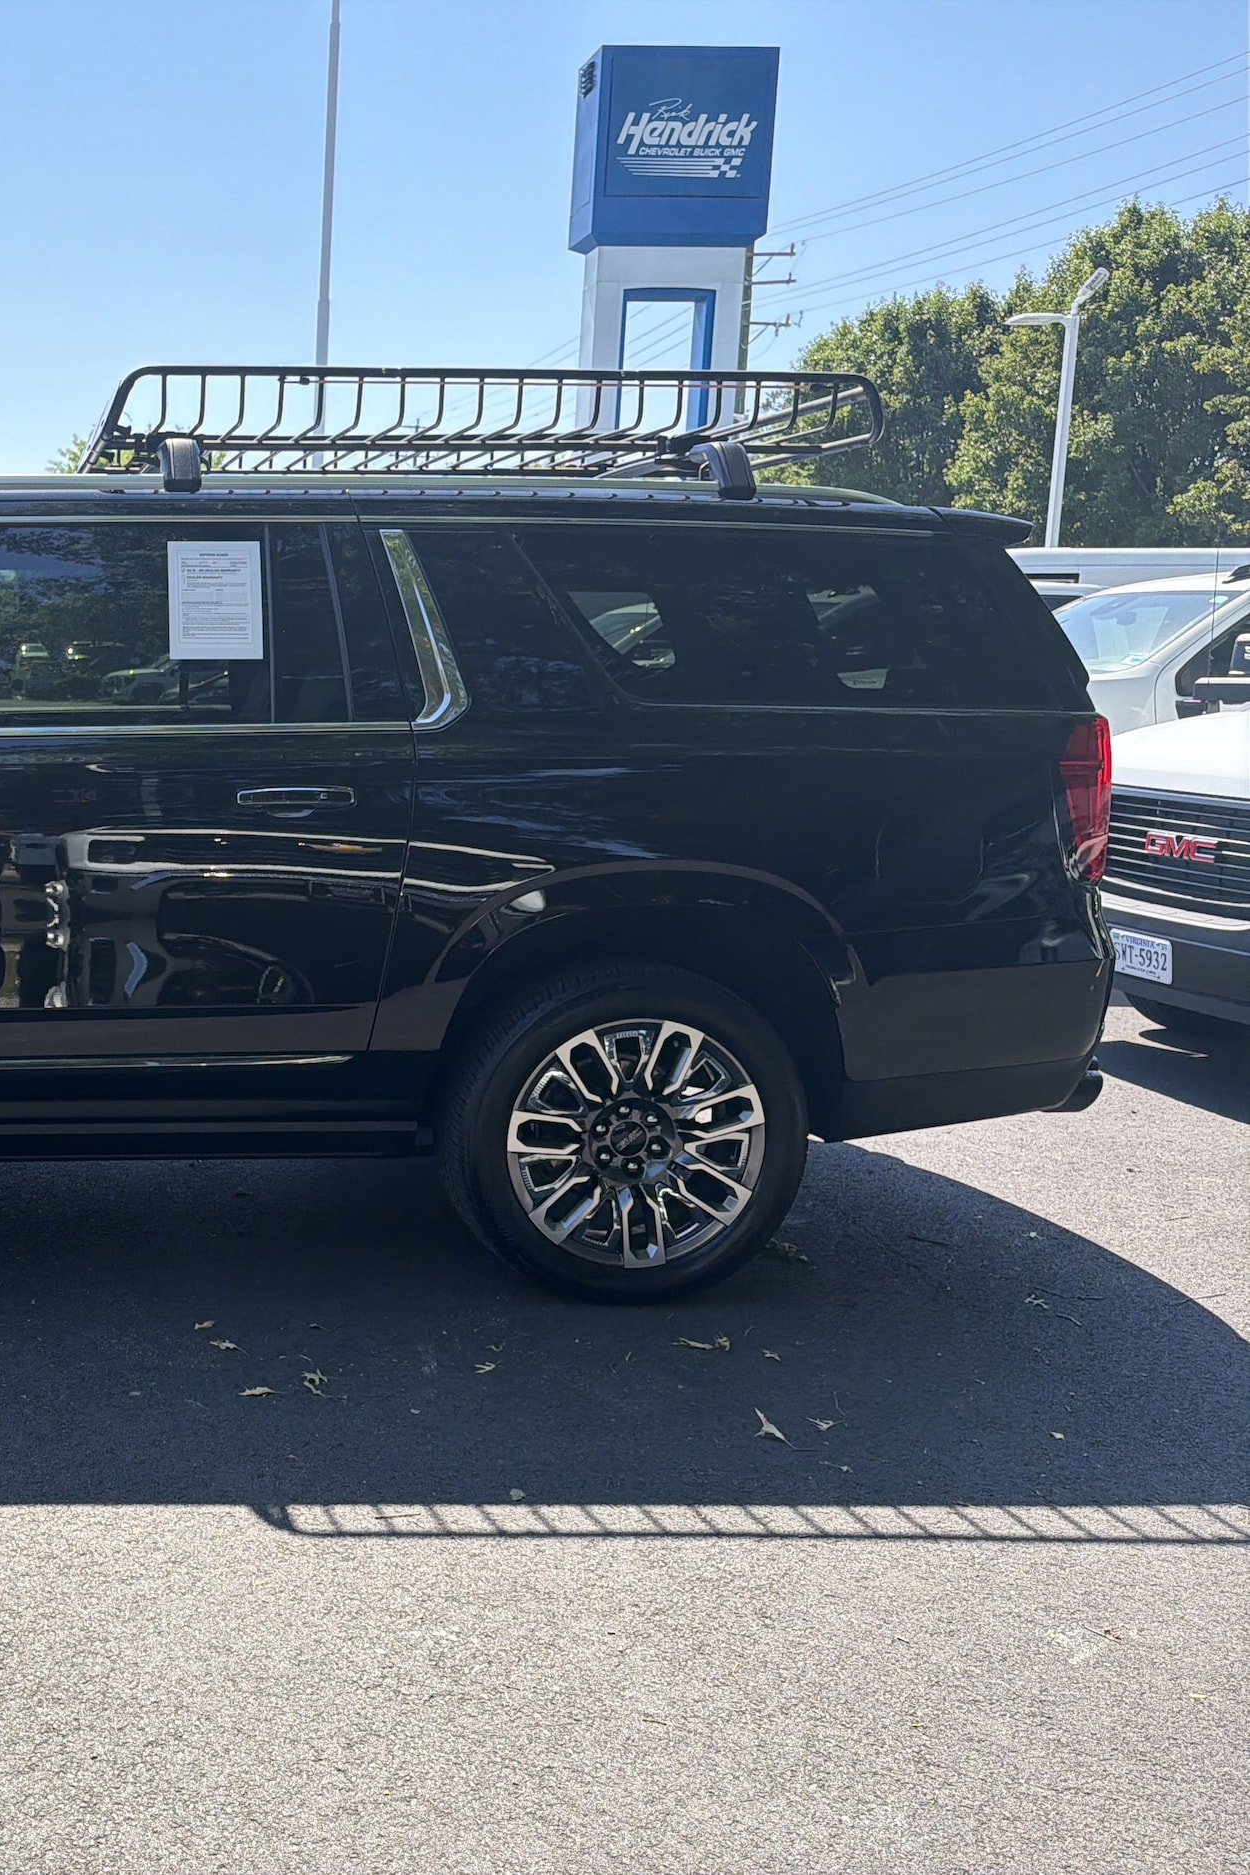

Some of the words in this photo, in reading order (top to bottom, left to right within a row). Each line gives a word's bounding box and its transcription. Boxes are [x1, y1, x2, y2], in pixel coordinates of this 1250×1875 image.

[616, 111, 759, 156] Hendrick
[638, 147, 692, 156] CHEVROLET
[693, 147, 722, 157] BUICK
[723, 147, 746, 157] GMC
[1144, 831, 1218, 863] GMC
[1125, 935, 1157, 949] VIRGINIA
